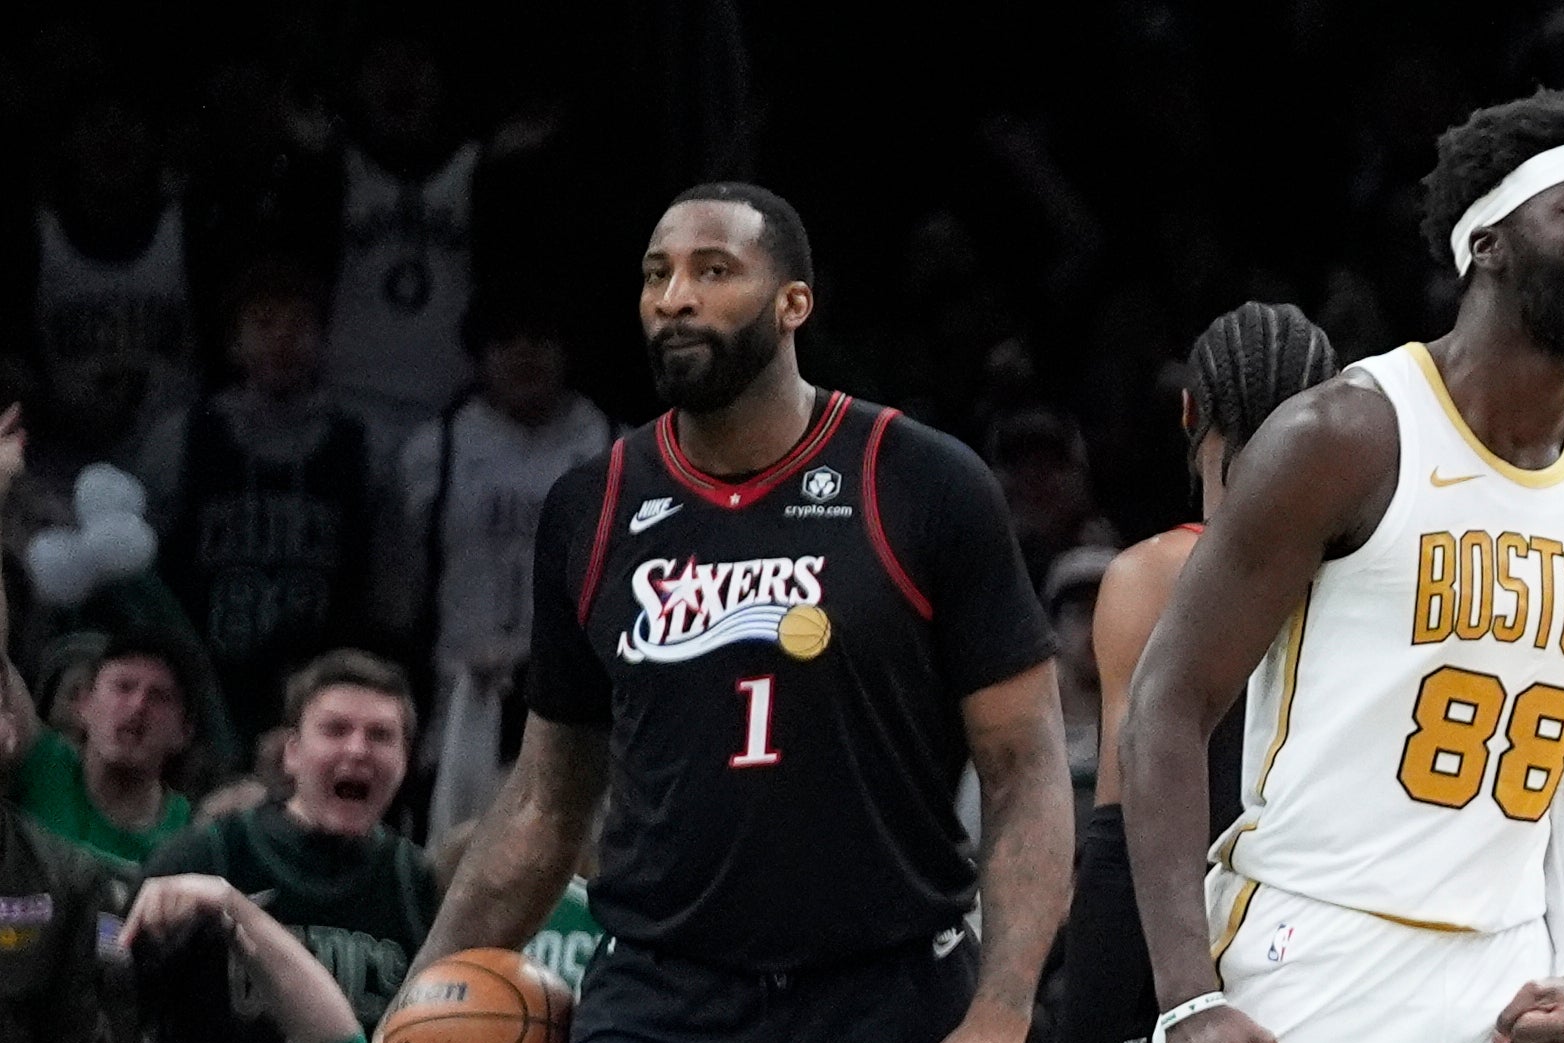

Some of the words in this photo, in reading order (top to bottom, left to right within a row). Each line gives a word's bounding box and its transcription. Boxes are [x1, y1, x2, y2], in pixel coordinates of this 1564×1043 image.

[637, 496, 673, 520] NIKE
[784, 504, 853, 518] crypto.com
[632, 554, 825, 645] SIXERS
[729, 673, 782, 769] 1
